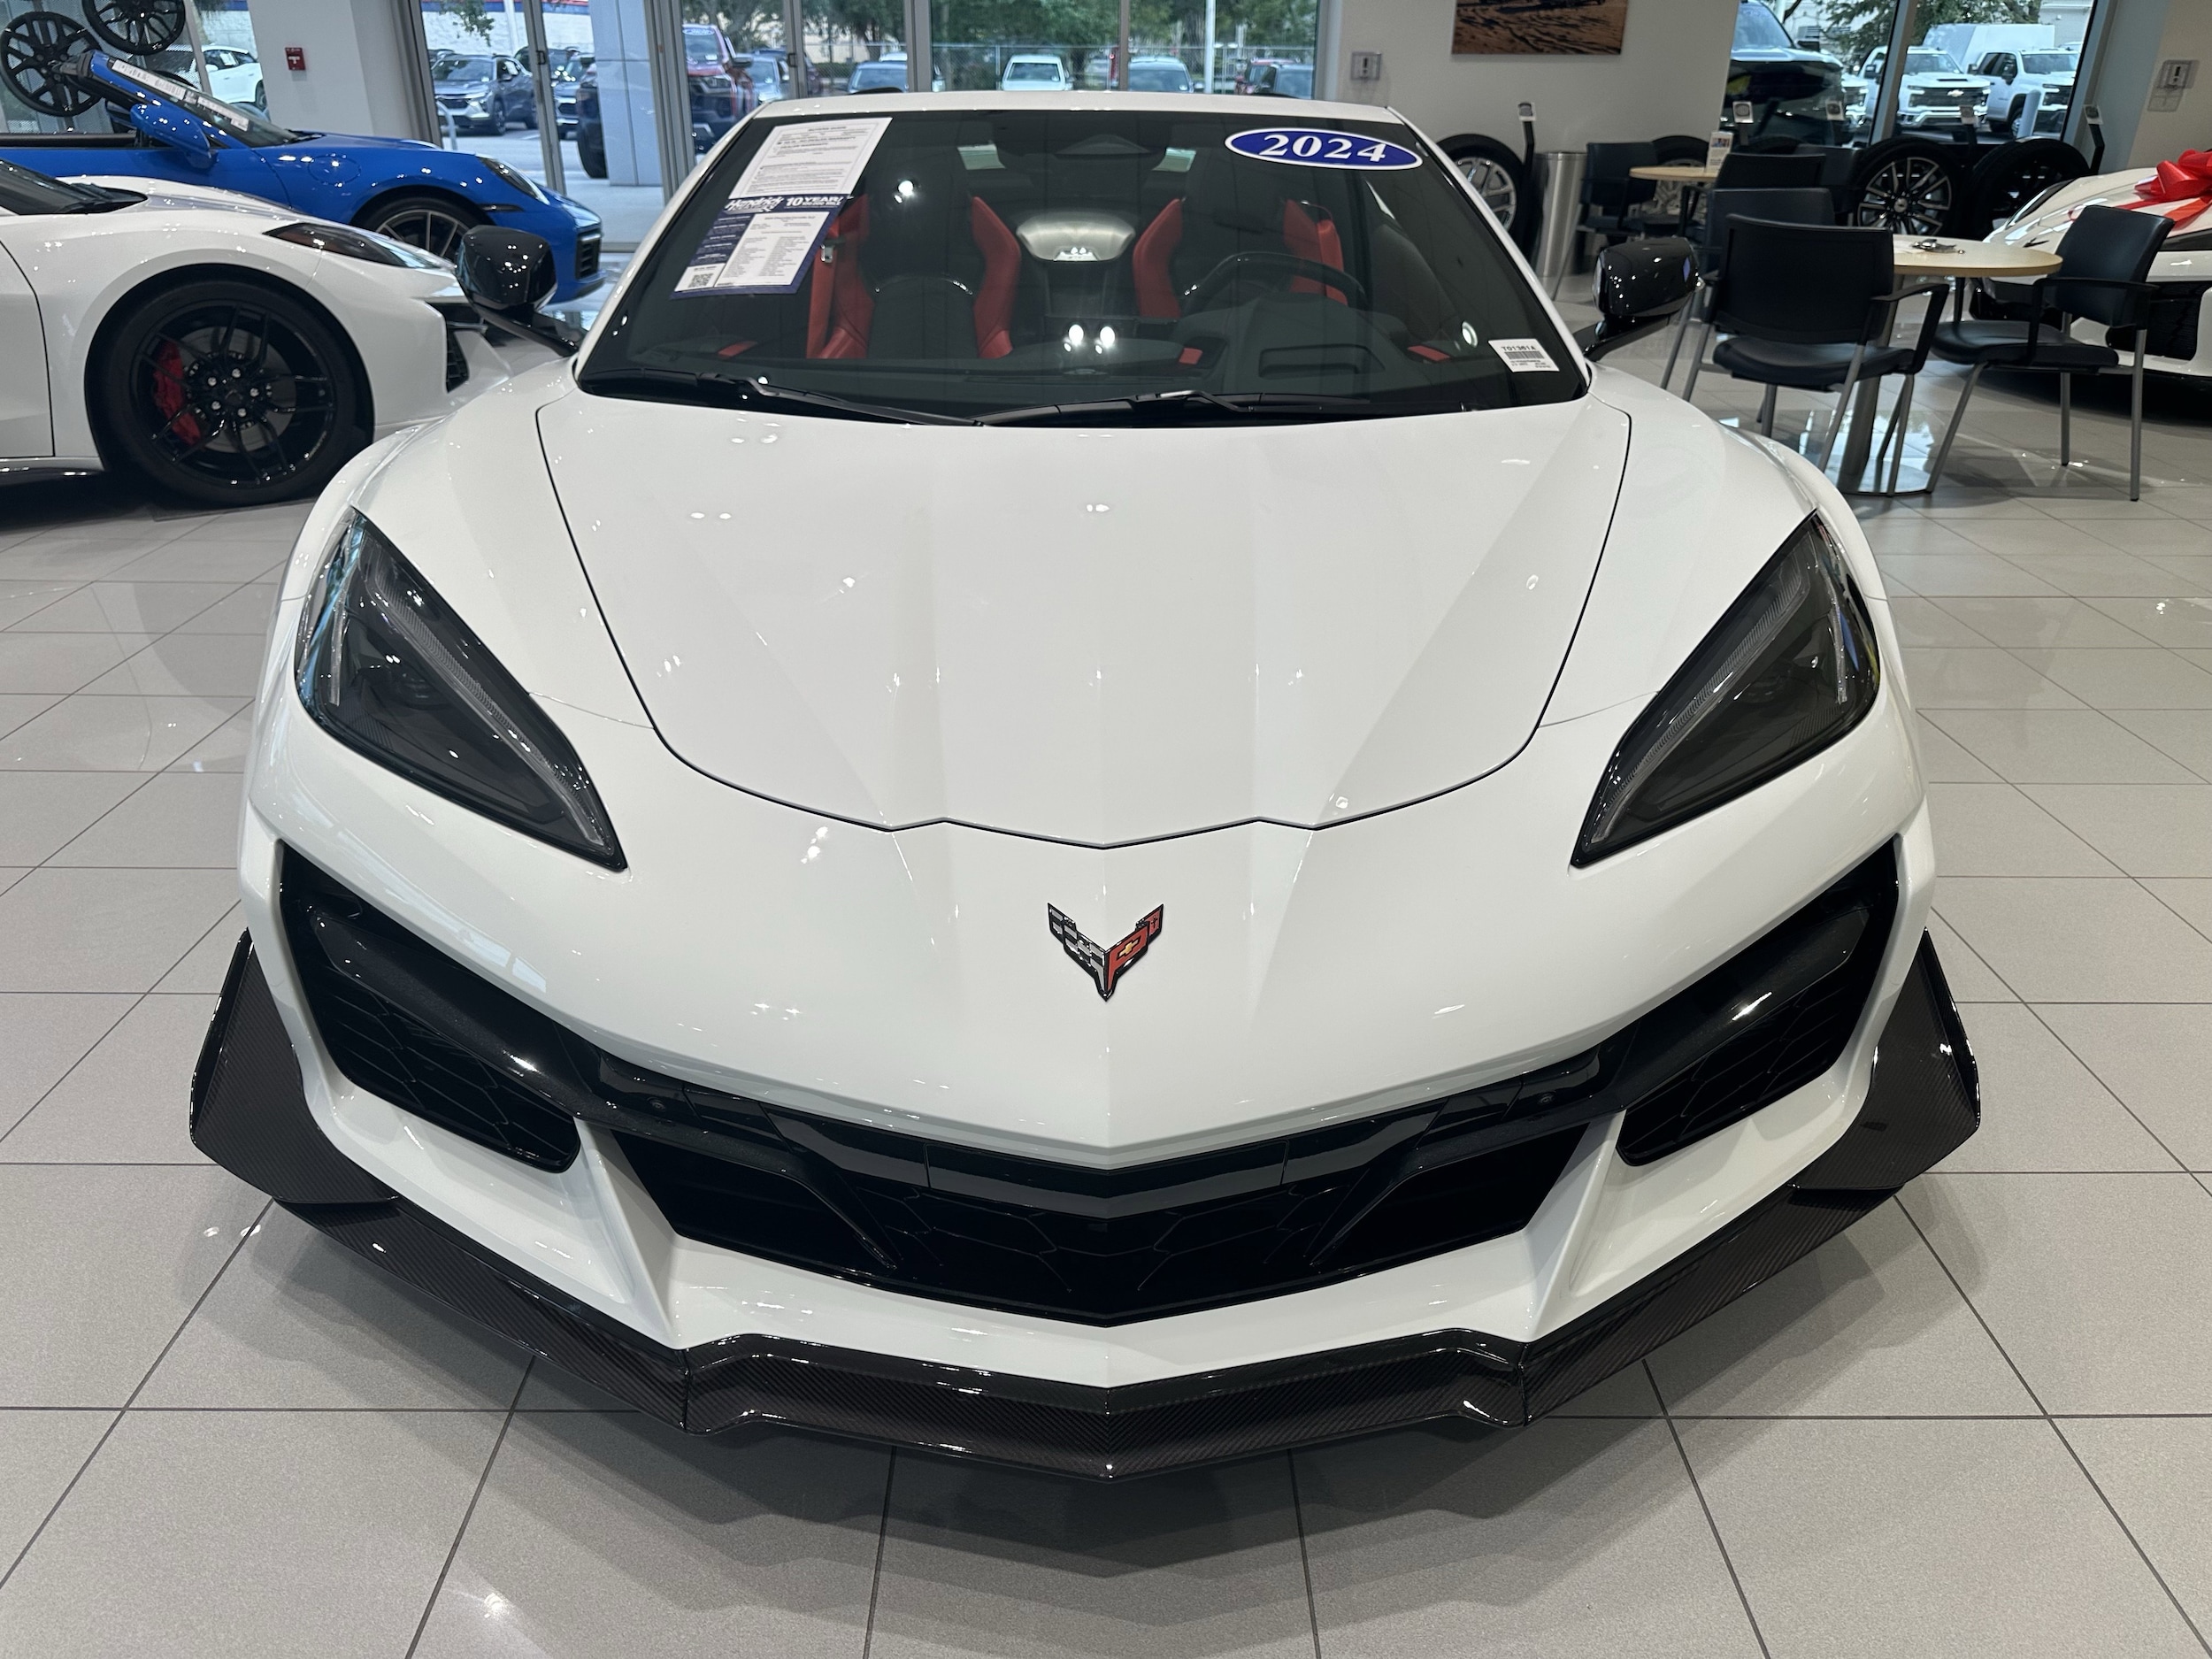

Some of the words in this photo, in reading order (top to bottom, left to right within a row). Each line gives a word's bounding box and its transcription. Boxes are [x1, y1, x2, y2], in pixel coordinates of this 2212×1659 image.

[1258, 134, 1387, 162] 2024
[724, 196, 785, 211] Hendrick
[786, 196, 804, 206] 10
